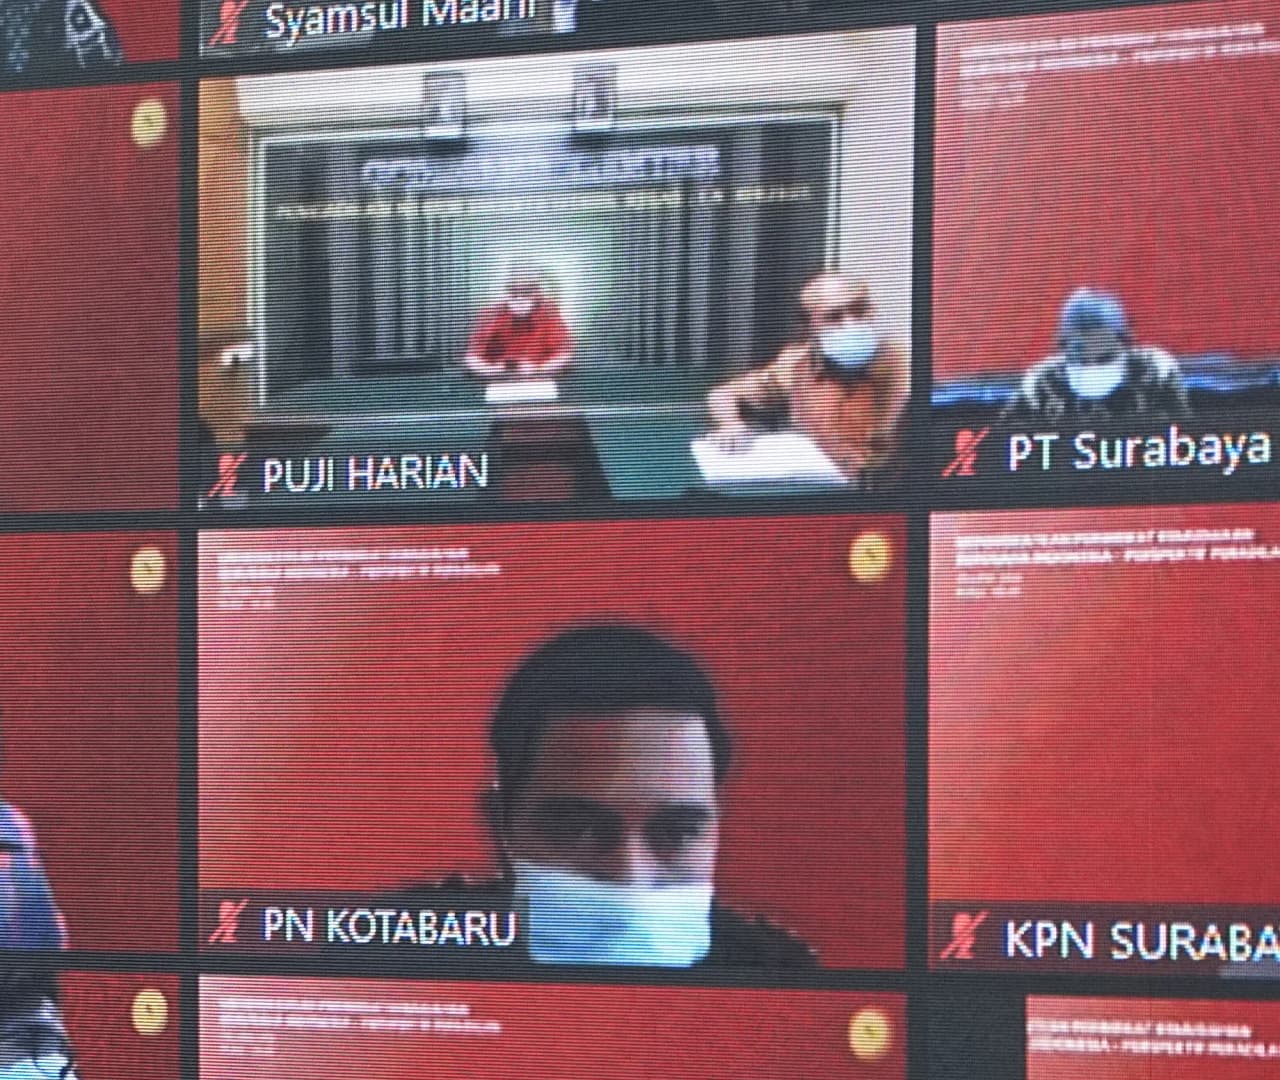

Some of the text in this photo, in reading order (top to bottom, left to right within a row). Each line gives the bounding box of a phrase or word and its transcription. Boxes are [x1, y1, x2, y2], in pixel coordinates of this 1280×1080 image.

[266, 0, 408, 47] Syamsul
[1008, 423, 1272, 475] PT Surabaya
[263, 453, 489, 493] PUJI HARIAN
[262, 906, 516, 947] PN KOTABARU
[1006, 920, 1280, 963] KPN SURABA
